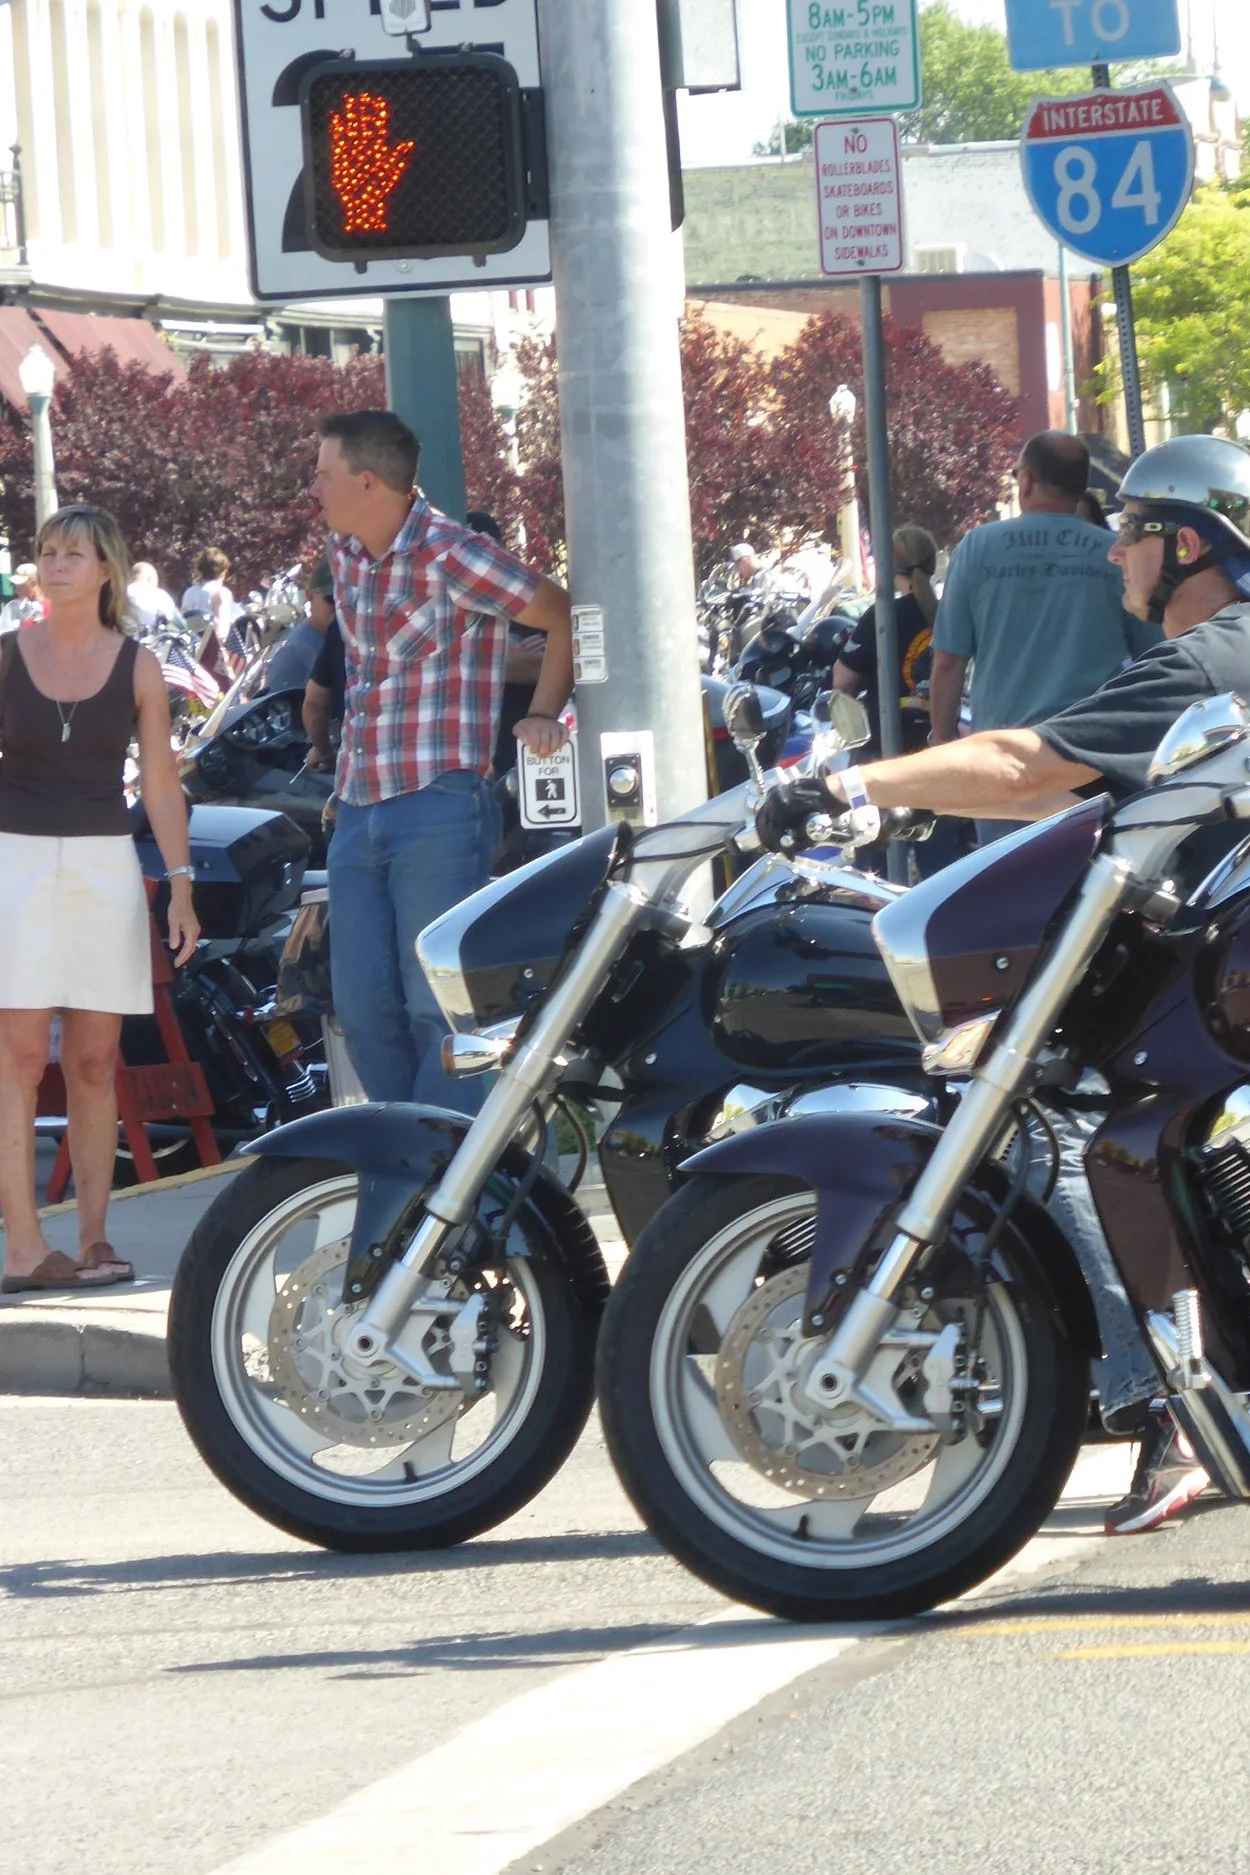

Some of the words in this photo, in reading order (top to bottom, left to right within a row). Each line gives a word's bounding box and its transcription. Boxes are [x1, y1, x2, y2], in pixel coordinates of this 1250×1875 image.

[1050, 0, 1130, 45] TO
[805, 44, 826, 62] NO
[834, 40, 900, 60] PARKING
[1043, 98, 1164, 131] INTERSTATE
[844, 134, 867, 154] NO
[822, 159, 891, 177] ROLLERBLADES
[823, 180, 894, 199] SKATEBOARDS
[1054, 140, 1162, 234] 84
[835, 205, 850, 219] OR
[854, 202, 883, 217] BIKES
[825, 226, 838, 240] ON
[842, 223, 897, 239] DOWNTOWN
[834, 244, 889, 260] SIDEWALKS
[1055, 528, 1103, 553] City
[527, 755, 570, 766] BUTTON
[538, 767, 560, 776] FOR
